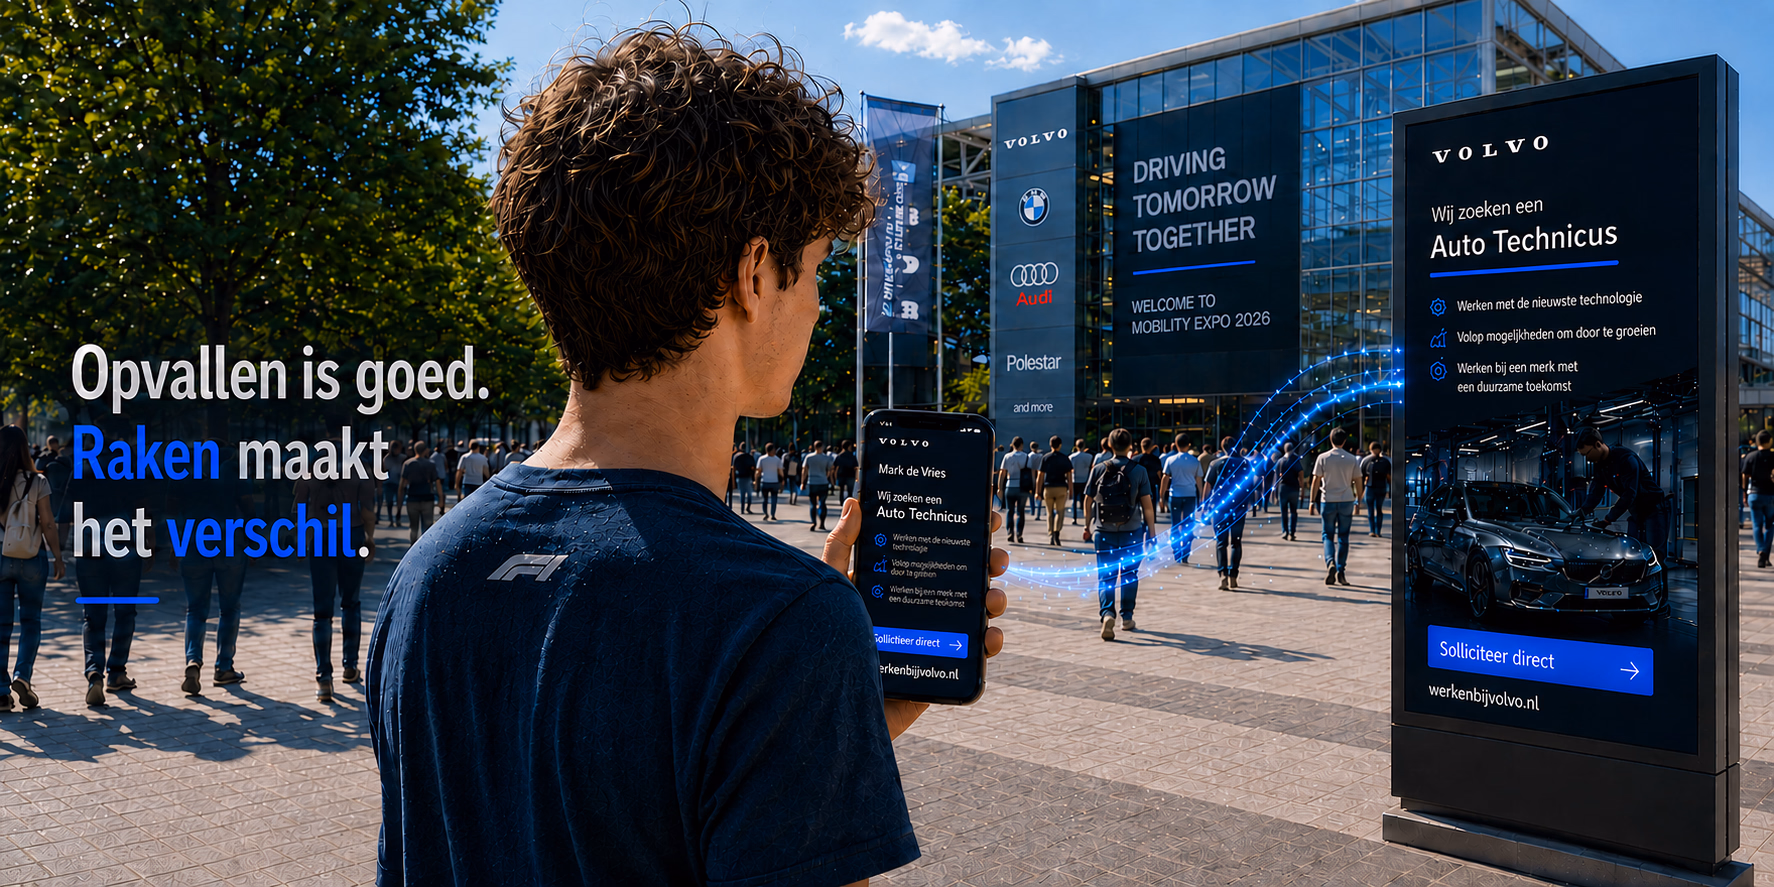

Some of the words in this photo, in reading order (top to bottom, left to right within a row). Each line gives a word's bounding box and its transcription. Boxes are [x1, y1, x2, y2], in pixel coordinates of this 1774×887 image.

[1004, 129, 1067, 148] VOLVO
[1432, 136, 1548, 163] VOLVO
[1134, 147, 1226, 184] DRIVING
[1133, 175, 1276, 218] TOMORROW
[1432, 205, 1453, 224] Wij
[1459, 201, 1510, 219] zoeken
[1516, 200, 1542, 213] een
[1133, 214, 1255, 252] TOGETHER
[1431, 235, 1485, 258] Auto
[1493, 224, 1617, 252] Technicus
[1016, 290, 1052, 306] Audi
[1132, 296, 1194, 313] WELCOME
[1198, 294, 1215, 307] TO
[1457, 300, 1493, 311] Werken
[1496, 299, 1514, 309] met
[1517, 297, 1529, 308] de
[1532, 296, 1577, 307] nieuwste
[1580, 291, 1642, 306] technologie
[1133, 317, 1190, 334] MOBILITY
[1195, 314, 1230, 329] EXPO
[1236, 311, 1270, 327] 2026
[1457, 331, 1484, 344] Volop
[1557, 330, 1573, 339] om
[1576, 327, 1600, 338] door
[1603, 327, 1613, 337] te
[1616, 324, 1655, 340] groeien
[1007, 354, 1061, 371] Polestar
[1457, 363, 1492, 373] Werken
[1496, 362, 1506, 375] bij
[1509, 364, 1526, 372] een
[1530, 361, 1555, 372] merk
[1558, 361, 1578, 371] met
[1458, 384, 1474, 392] een
[1477, 381, 1523, 392] duurzame
[1526, 380, 1571, 391] toekomst
[1014, 402, 1029, 412] and
[1032, 404, 1053, 412] more
[879, 438, 929, 447] VOLVO
[879, 464, 904, 475] Mark
[907, 466, 920, 476] de
[921, 467, 947, 478] Vries
[878, 491, 891, 503] Wij
[893, 493, 924, 502] zoeken
[877, 506, 906, 518] Auto
[909, 508, 968, 523] Technicus
[916, 637, 941, 647] direct
[1440, 641, 1508, 663] Solliciteer
[1513, 649, 1554, 669] direct
[1429, 684, 1539, 710] werkenbijvolvo.nl
